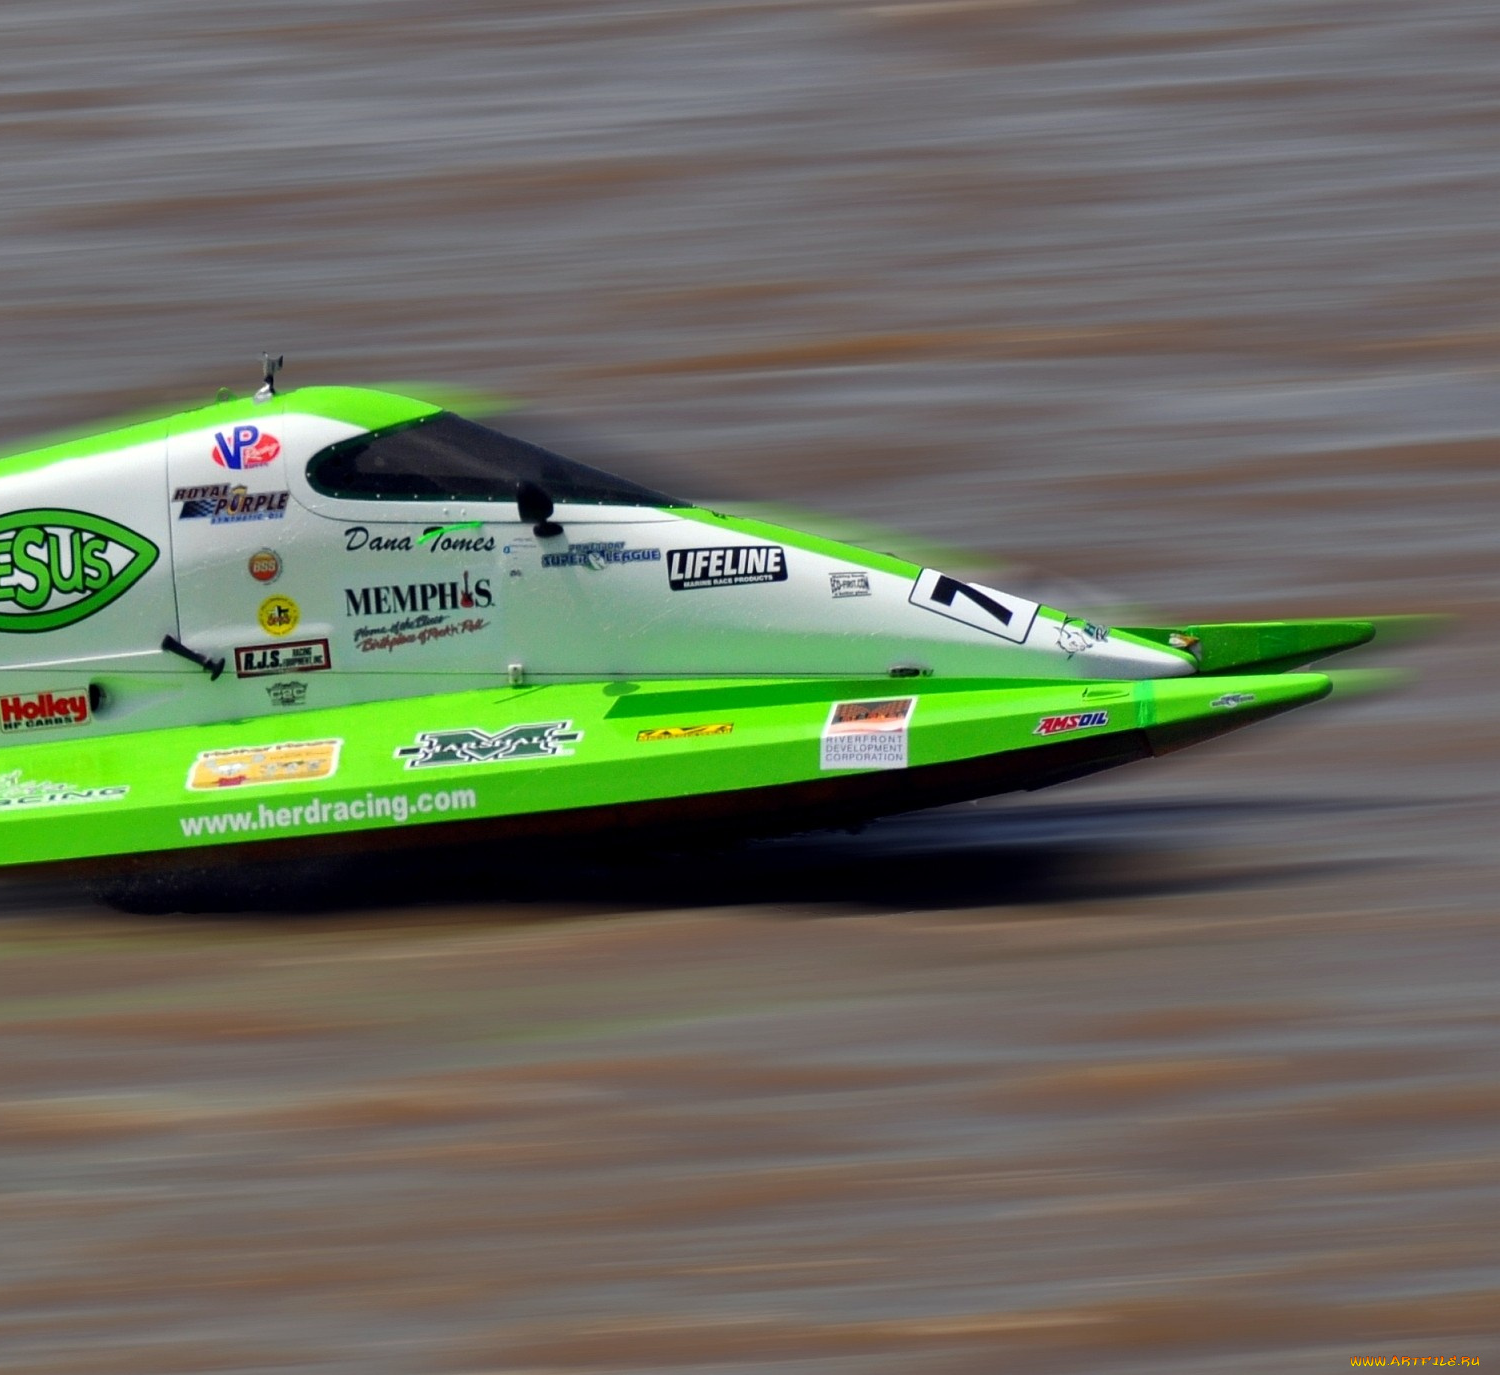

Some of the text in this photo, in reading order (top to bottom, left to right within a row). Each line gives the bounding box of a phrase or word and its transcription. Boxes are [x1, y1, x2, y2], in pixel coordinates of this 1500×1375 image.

[215, 425, 259, 469] VP
[174, 485, 230, 500] ROYAL
[214, 491, 289, 515] PURPLE
[344, 526, 414, 552] Dana
[418, 522, 497, 553] Tomes
[542, 549, 661, 568] SUPER LEAGUE
[670, 548, 782, 580] LIFELINE
[683, 574, 774, 588] MARINE RACE PRODUCTS
[931, 575, 1013, 627] 7
[244, 649, 283, 671] R.J.S.
[0, 693, 87, 723] Holley
[1038, 712, 1108, 734] AMSOIL
[825, 744, 903, 753] DEVELOPMENT
[826, 735, 903, 743] RIVERFRONT
[825, 753, 903, 761] CORPORATION
[180, 788, 477, 837] www.herdracing.com
